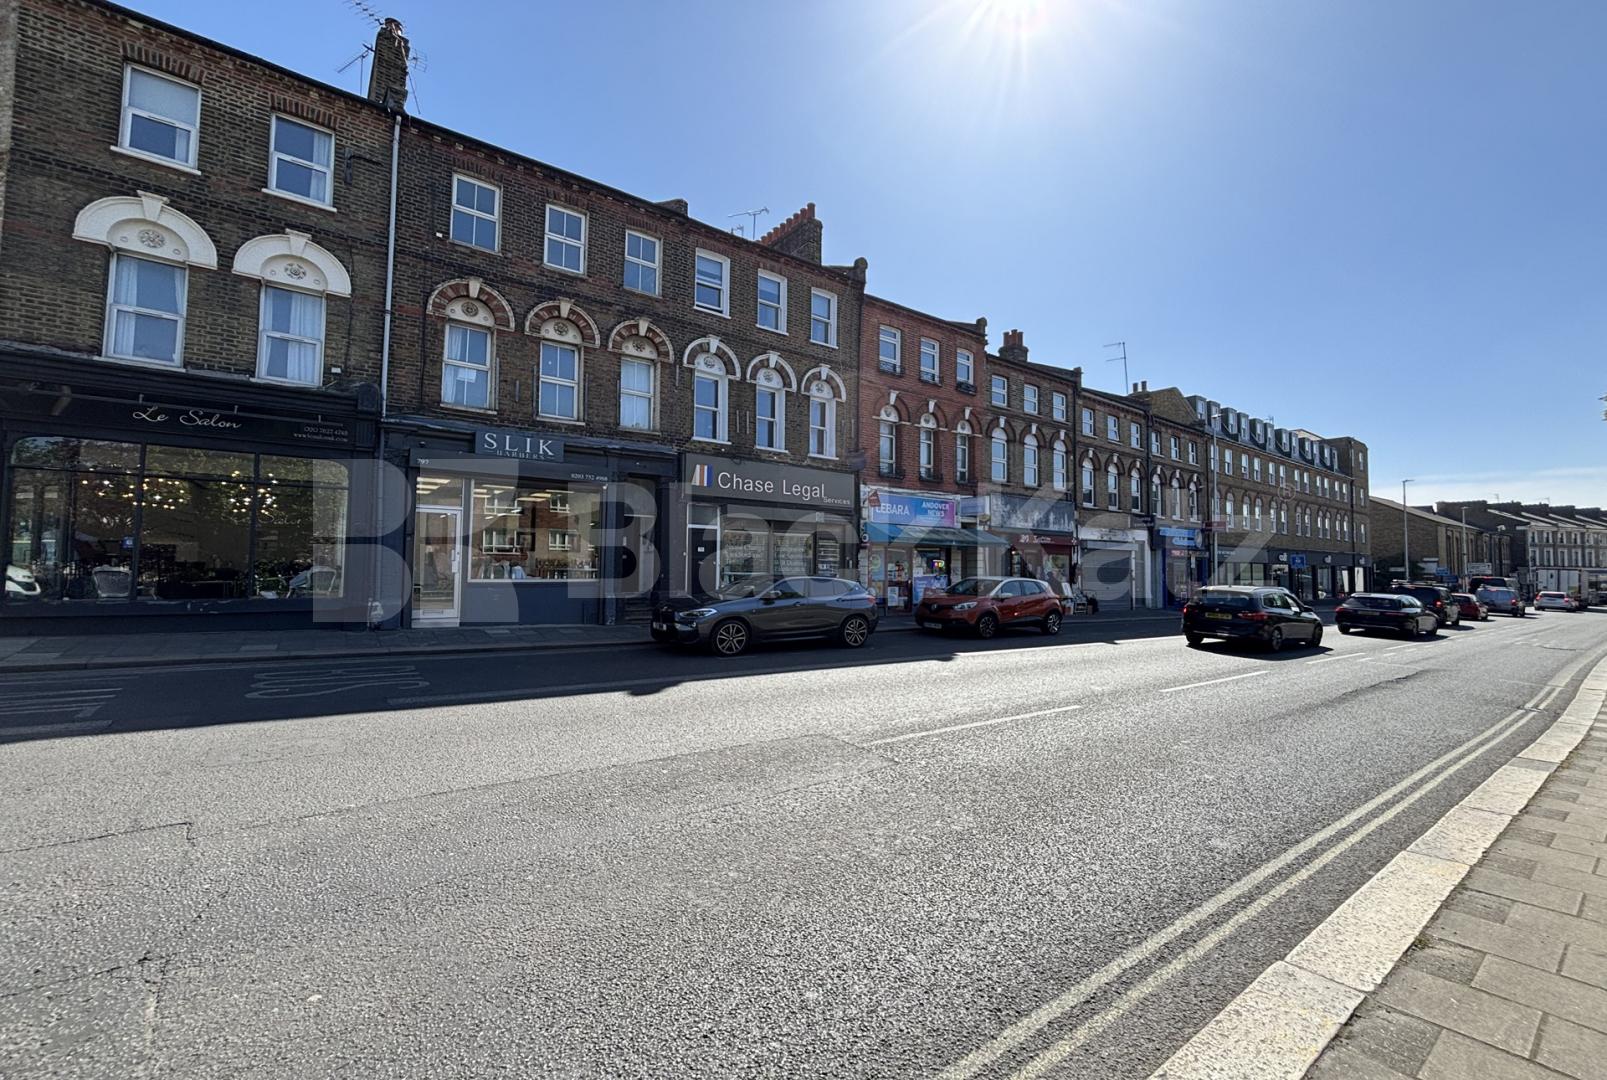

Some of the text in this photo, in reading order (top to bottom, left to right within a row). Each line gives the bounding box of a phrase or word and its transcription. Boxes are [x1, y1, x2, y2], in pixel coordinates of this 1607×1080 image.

[132, 405, 242, 429] Le Salon
[484, 432, 555, 456] SLIK
[496, 449, 546, 460] BARBERS
[717, 472, 825, 501] Chase Legal
[822, 496, 851, 506] Services
[921, 501, 950, 511] ANDOVER
[875, 503, 911, 516] LEBARA
[927, 509, 945, 518] NEWS
